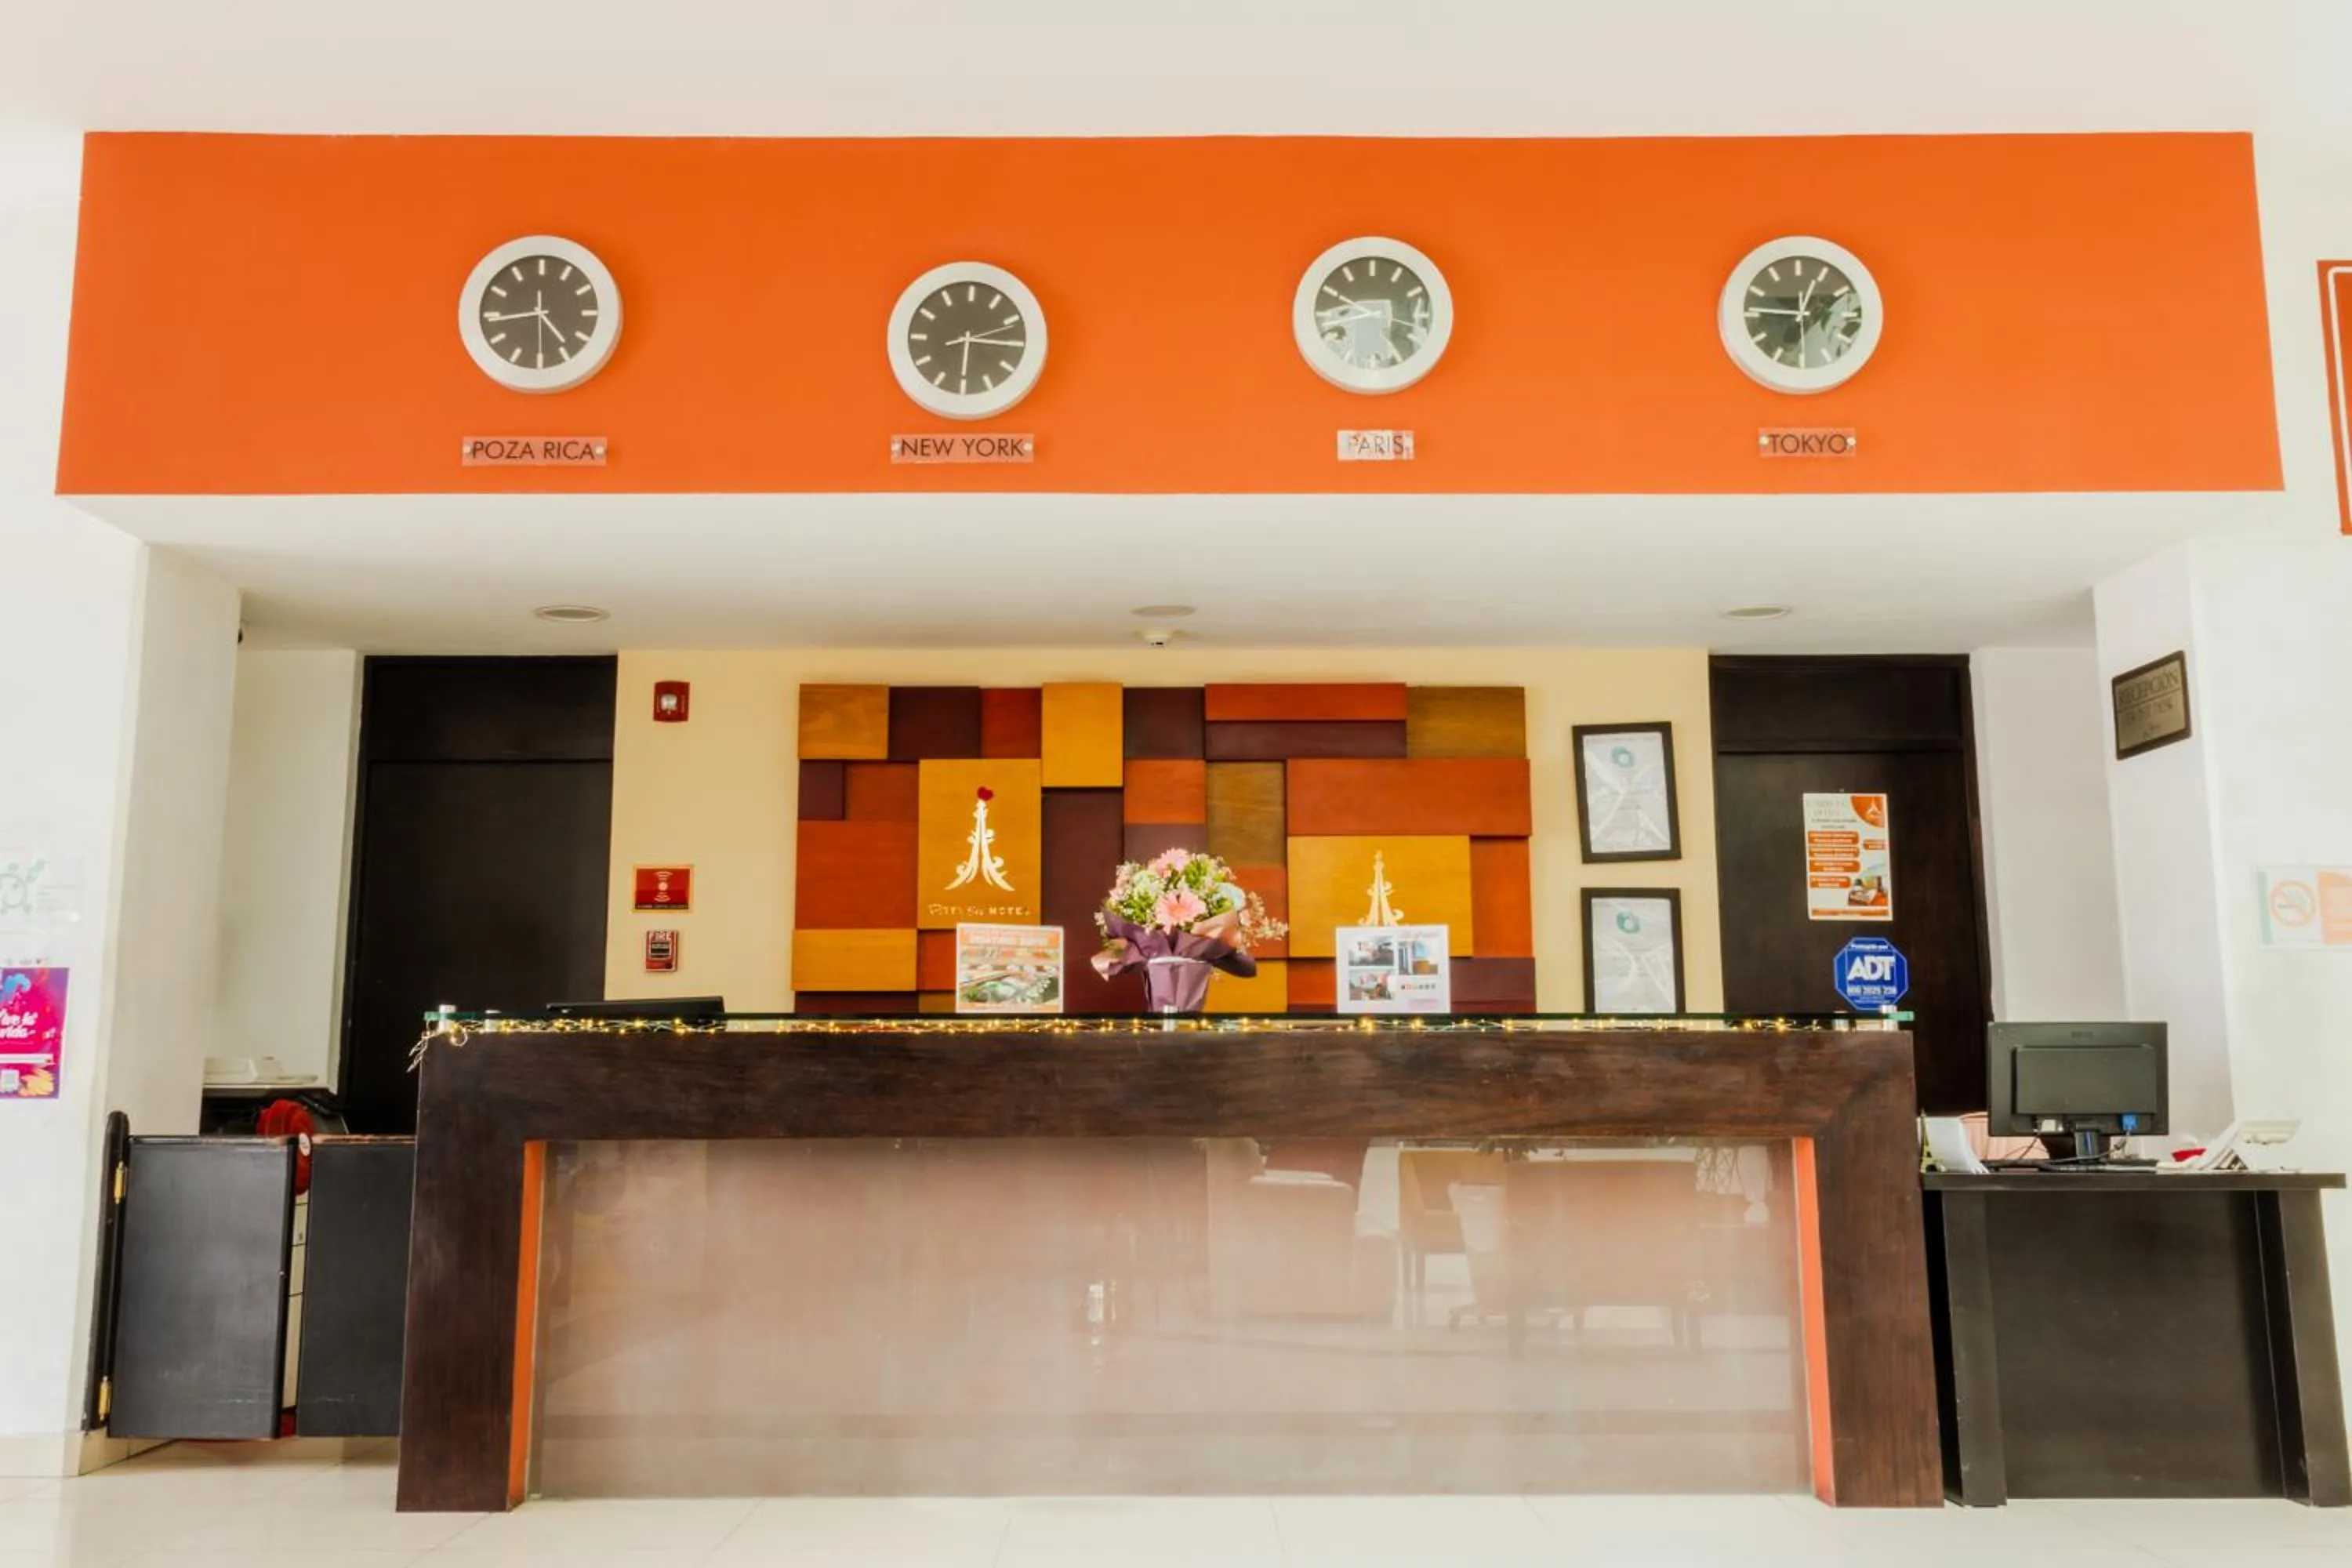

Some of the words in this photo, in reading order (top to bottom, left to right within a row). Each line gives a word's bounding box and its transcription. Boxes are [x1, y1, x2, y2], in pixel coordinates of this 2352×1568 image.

[472, 441, 535, 459] POZA
[543, 441, 595, 460] RICA
[902, 438, 954, 457] NEW
[961, 438, 1025, 457] YORK
[1348, 434, 1404, 455] PARIS
[1768, 434, 1847, 454] TOKYO
[1847, 955, 1896, 982] ADT
